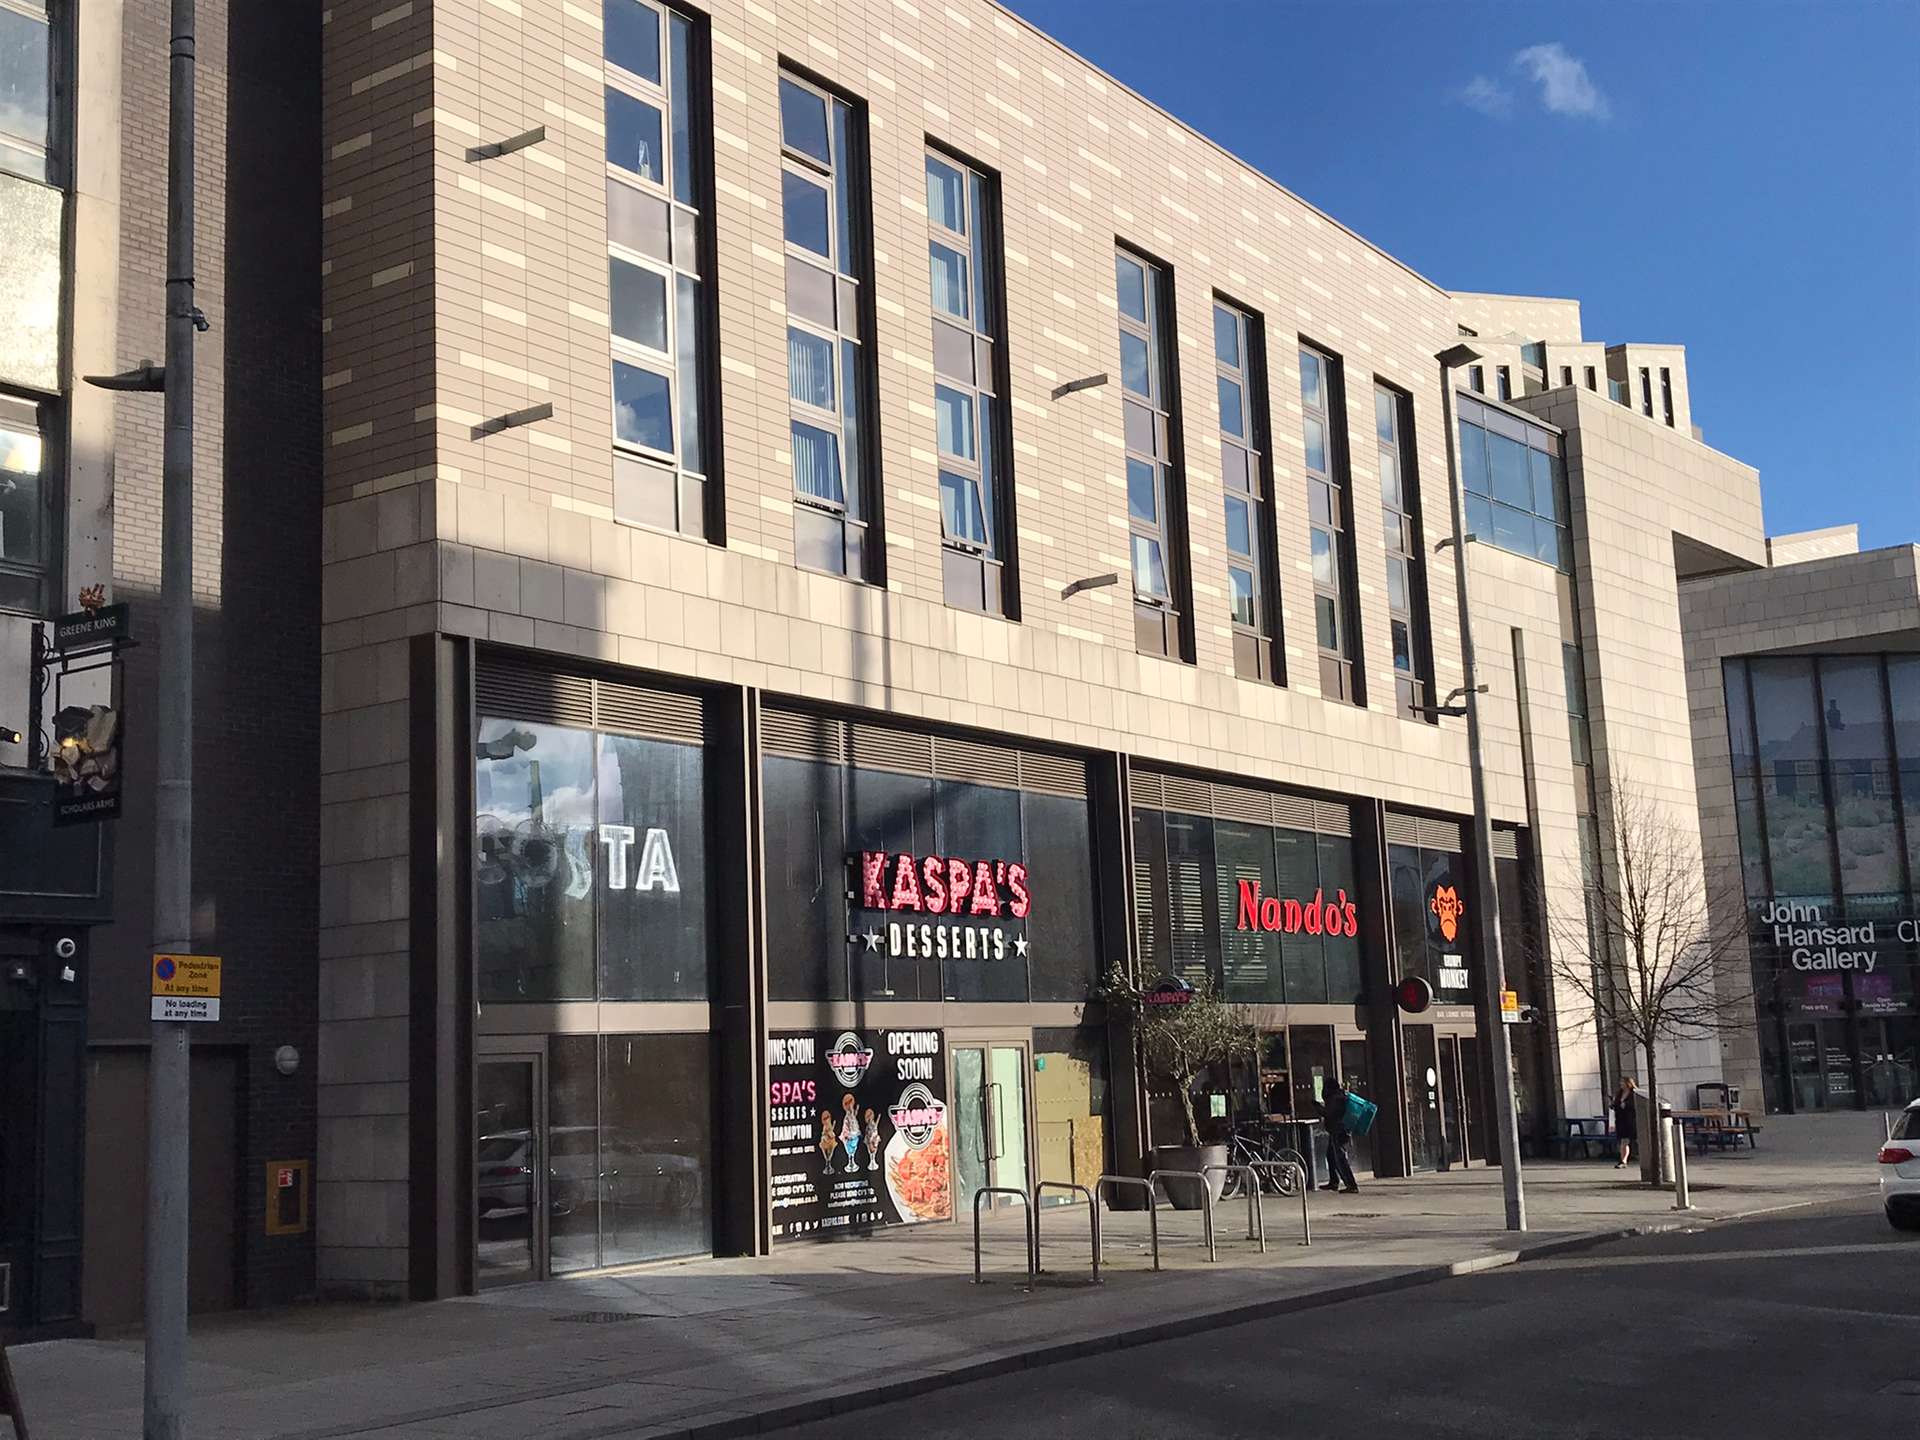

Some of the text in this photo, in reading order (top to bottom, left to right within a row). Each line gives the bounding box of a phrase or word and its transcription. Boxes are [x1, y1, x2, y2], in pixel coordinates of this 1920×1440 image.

[59, 616, 116, 638] GREENE KING
[862, 851, 1031, 918] KASPA'S
[1237, 879, 1357, 937] Nando's
[1761, 900, 1821, 923] John
[890, 923, 1004, 960] DESSERTS
[1774, 922, 1875, 947] Hansard
[1897, 919, 1920, 943] CI
[178, 961, 219, 970] Pedestrian
[1792, 947, 1877, 973] Gallery
[189, 971, 207, 979] Zone
[1439, 968, 1469, 989] MONKEY
[164, 984, 208, 994] At any time
[165, 999, 207, 1010] No loading
[175, 1010, 189, 1018] any
[190, 1009, 208, 1017] time
[787, 1037, 815, 1065] SOON!
[888, 1031, 938, 1055] OPENING
[897, 1057, 932, 1080] SOON!
[769, 1080, 816, 1104] SPA'S
